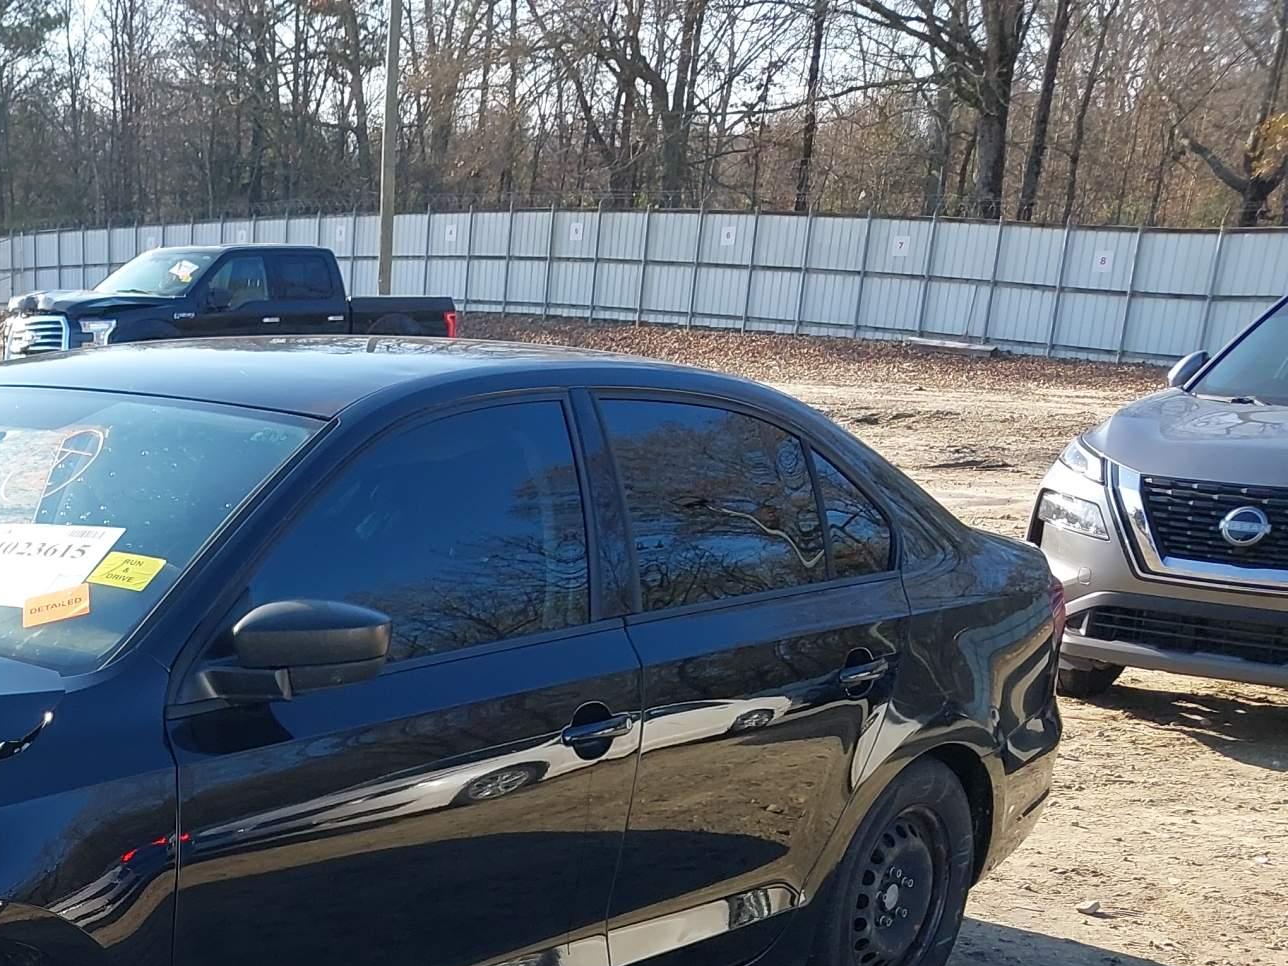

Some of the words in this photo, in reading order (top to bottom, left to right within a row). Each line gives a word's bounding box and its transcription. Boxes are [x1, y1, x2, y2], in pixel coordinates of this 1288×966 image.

[123, 558, 145, 567] RUN
[105, 573, 136, 583] DRIVE
[29, 596, 83, 615] DETAILED
